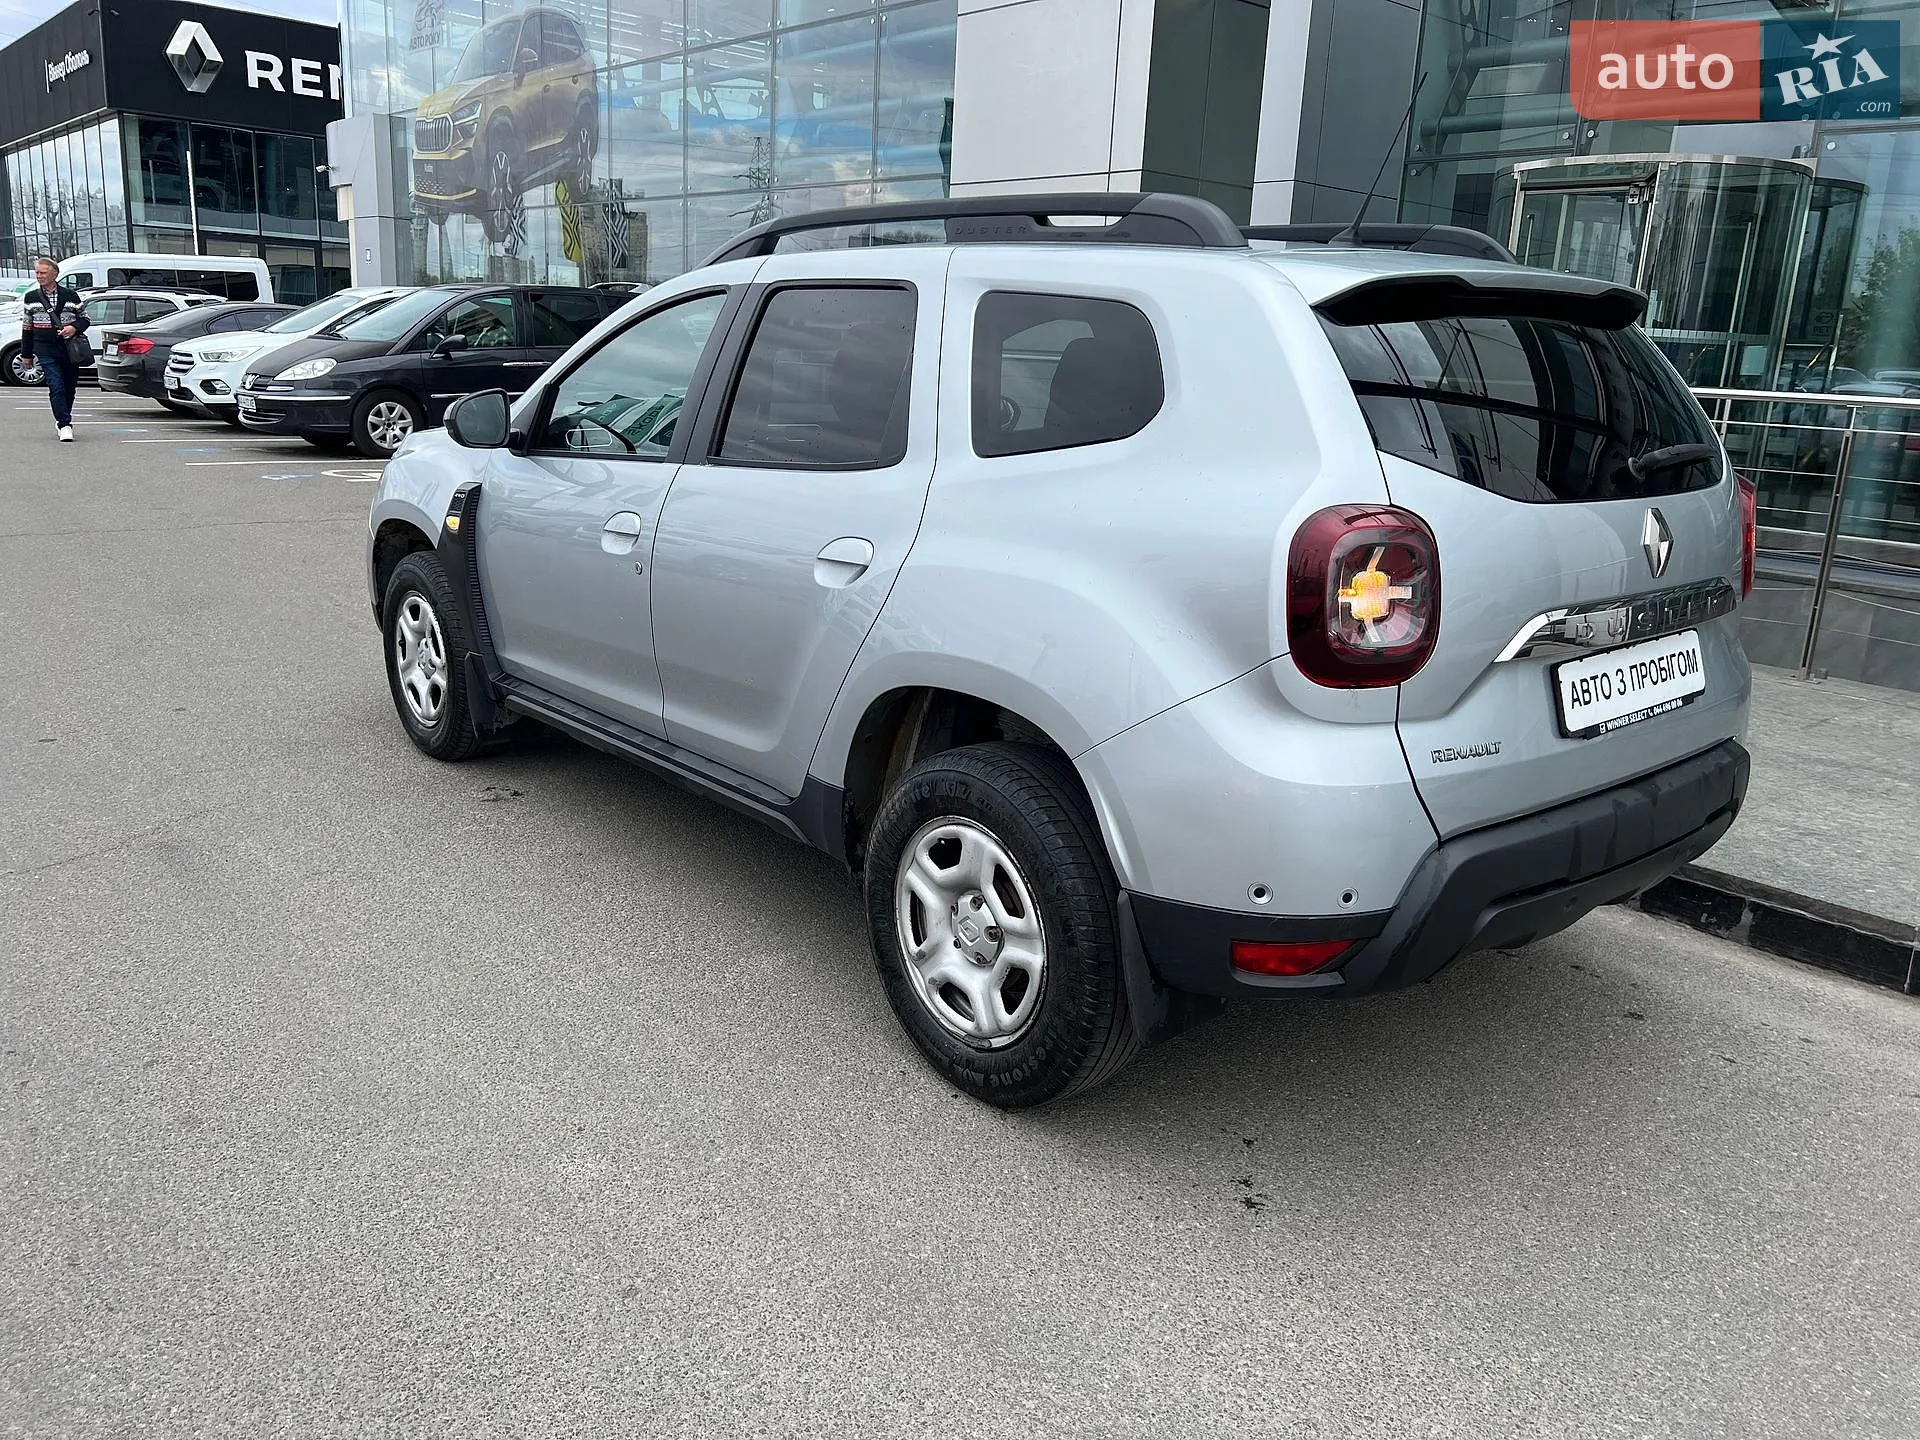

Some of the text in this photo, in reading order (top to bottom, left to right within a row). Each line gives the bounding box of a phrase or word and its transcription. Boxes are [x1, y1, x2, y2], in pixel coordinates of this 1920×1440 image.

[954, 226, 1027, 235] DUSTER
[1571, 672, 1612, 709] АВТО
[1629, 647, 1699, 692] ПРОБІГОМ
[1606, 715, 1629, 731] WINNER
[1629, 710, 1648, 724] SELECT
[1430, 741, 1502, 764] RENAULT
